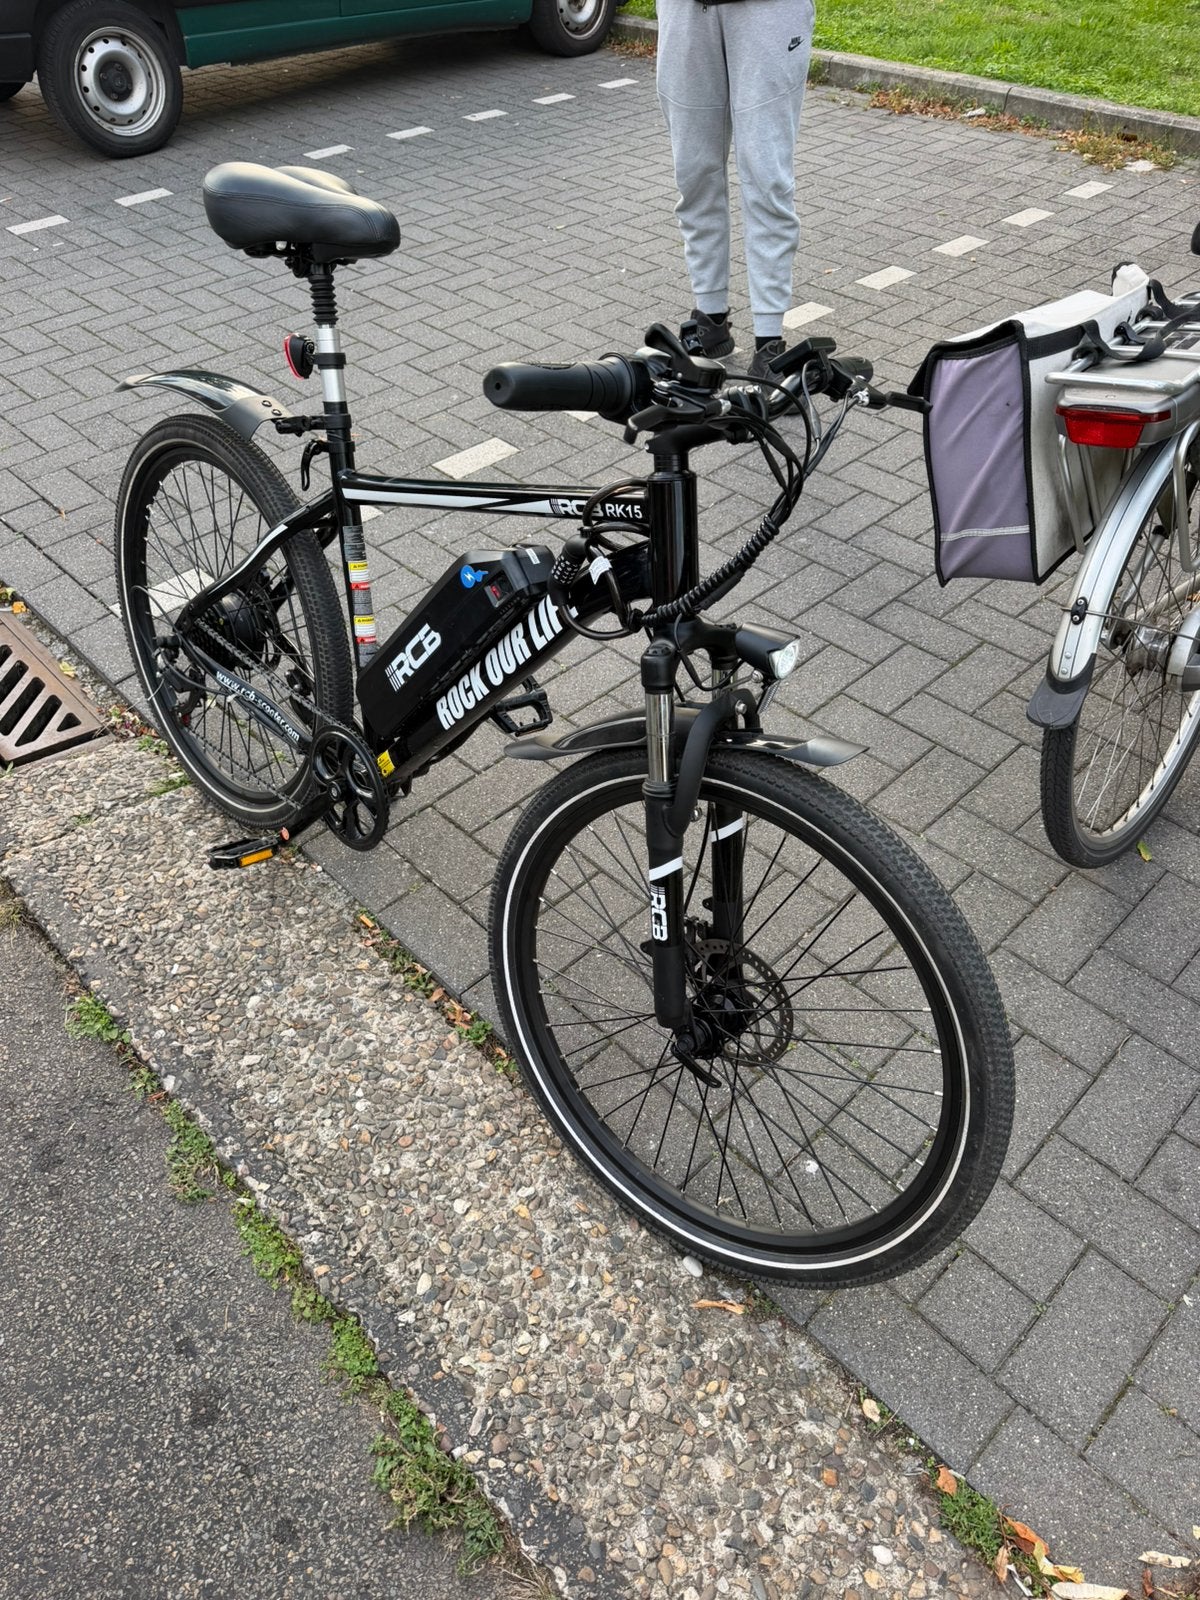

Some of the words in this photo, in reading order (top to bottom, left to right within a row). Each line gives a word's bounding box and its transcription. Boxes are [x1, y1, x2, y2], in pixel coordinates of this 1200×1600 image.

[605, 503, 643, 519] RK15
[384, 622, 442, 692] RCB
[436, 661, 490, 730] ROCK
[485, 622, 532, 687] OUR
[527, 593, 579, 651] LIF
[216, 671, 300, 742] www.rcb-scooter.com
[650, 884, 668, 941] RCB
